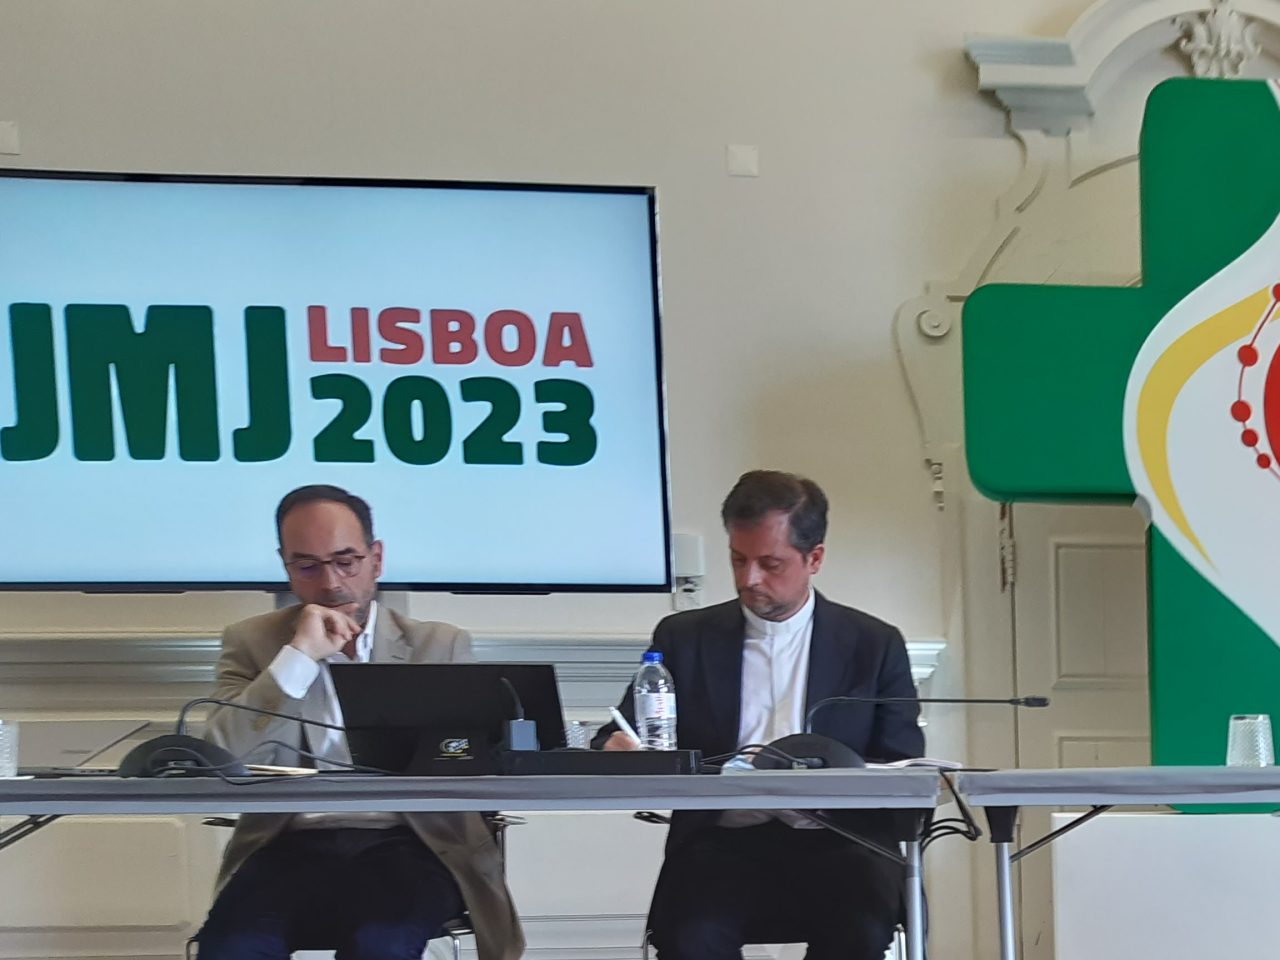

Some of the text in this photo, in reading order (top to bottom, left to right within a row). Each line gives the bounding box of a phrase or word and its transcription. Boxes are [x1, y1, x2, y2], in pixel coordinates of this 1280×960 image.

[0, 302, 292, 462] JMJ
[307, 305, 593, 368] LISBOA
[310, 373, 597, 466] 2023
